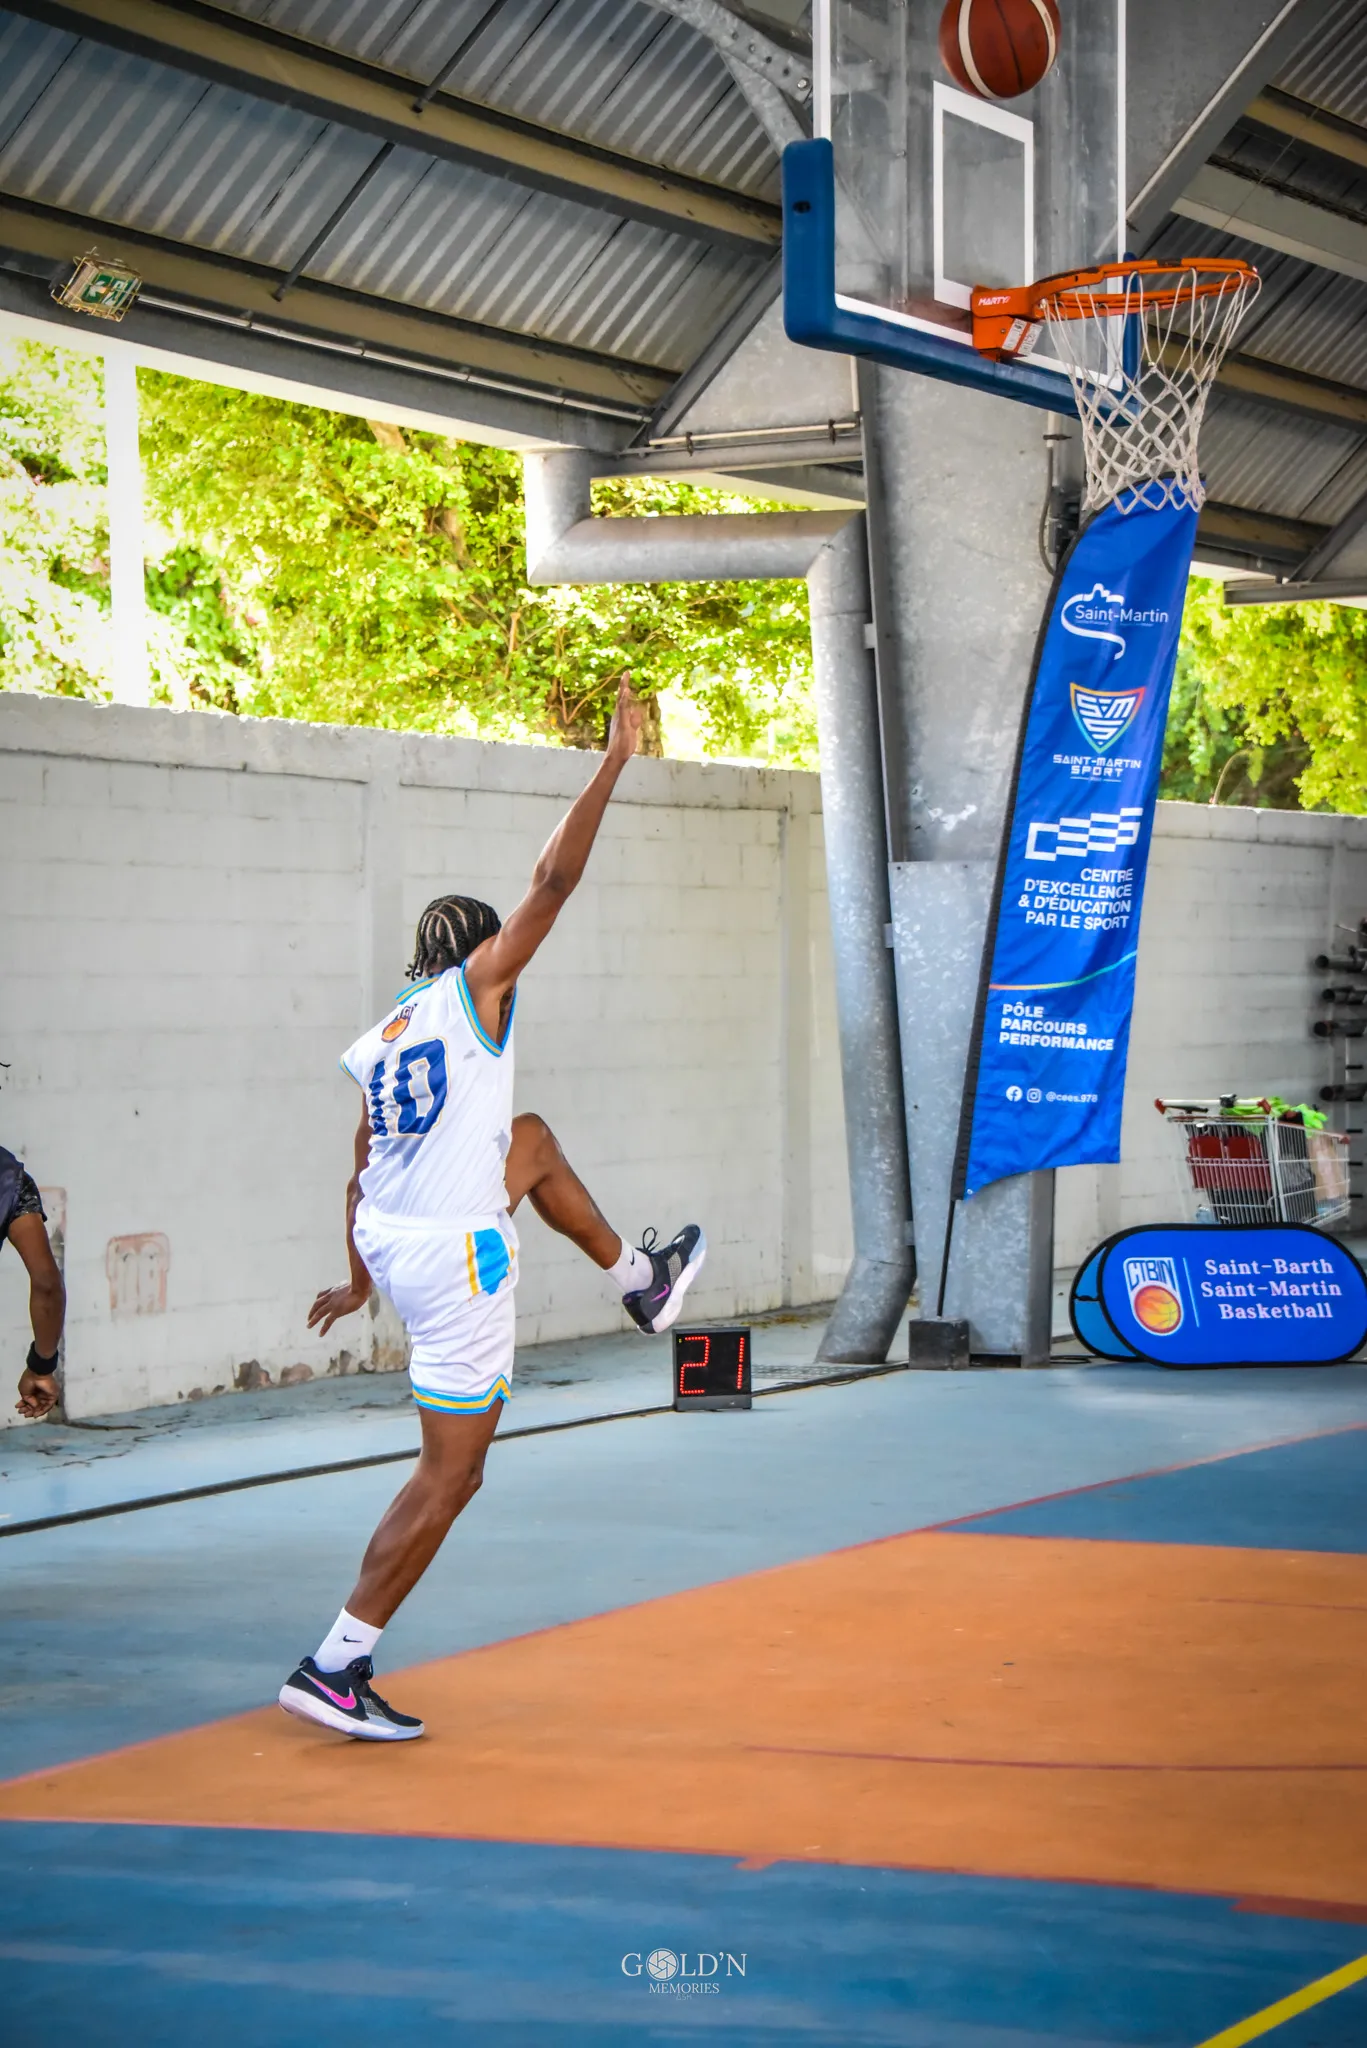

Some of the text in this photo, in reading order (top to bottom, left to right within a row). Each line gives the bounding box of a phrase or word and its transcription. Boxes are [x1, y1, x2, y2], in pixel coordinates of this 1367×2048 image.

[978, 295, 1011, 306] MARTY
[1074, 604, 1169, 623] Saint-Martin
[1053, 754, 1142, 769] SAINT-MARTIN
[1070, 765, 1123, 778] SPORT
[1080, 867, 1134, 883] CENTRE
[1024, 878, 1133, 899] D'EXCELLENCE
[1018, 894, 1131, 914] & D'ÉDUCATION
[1025, 910, 1130, 931] PAR LE SPORT
[1002, 1001, 1044, 1018] PÔLE
[1000, 1017, 1087, 1035] PARCOURS
[999, 1031, 1114, 1051] PERFORMANCE
[368, 1036, 449, 1137] 10
[1204, 1257, 1334, 1276] Saint-Barth
[1200, 1280, 1342, 1298] Saint-Martin
[1218, 1302, 1333, 1320] Basketball
[680, 1335, 745, 1395] 21
